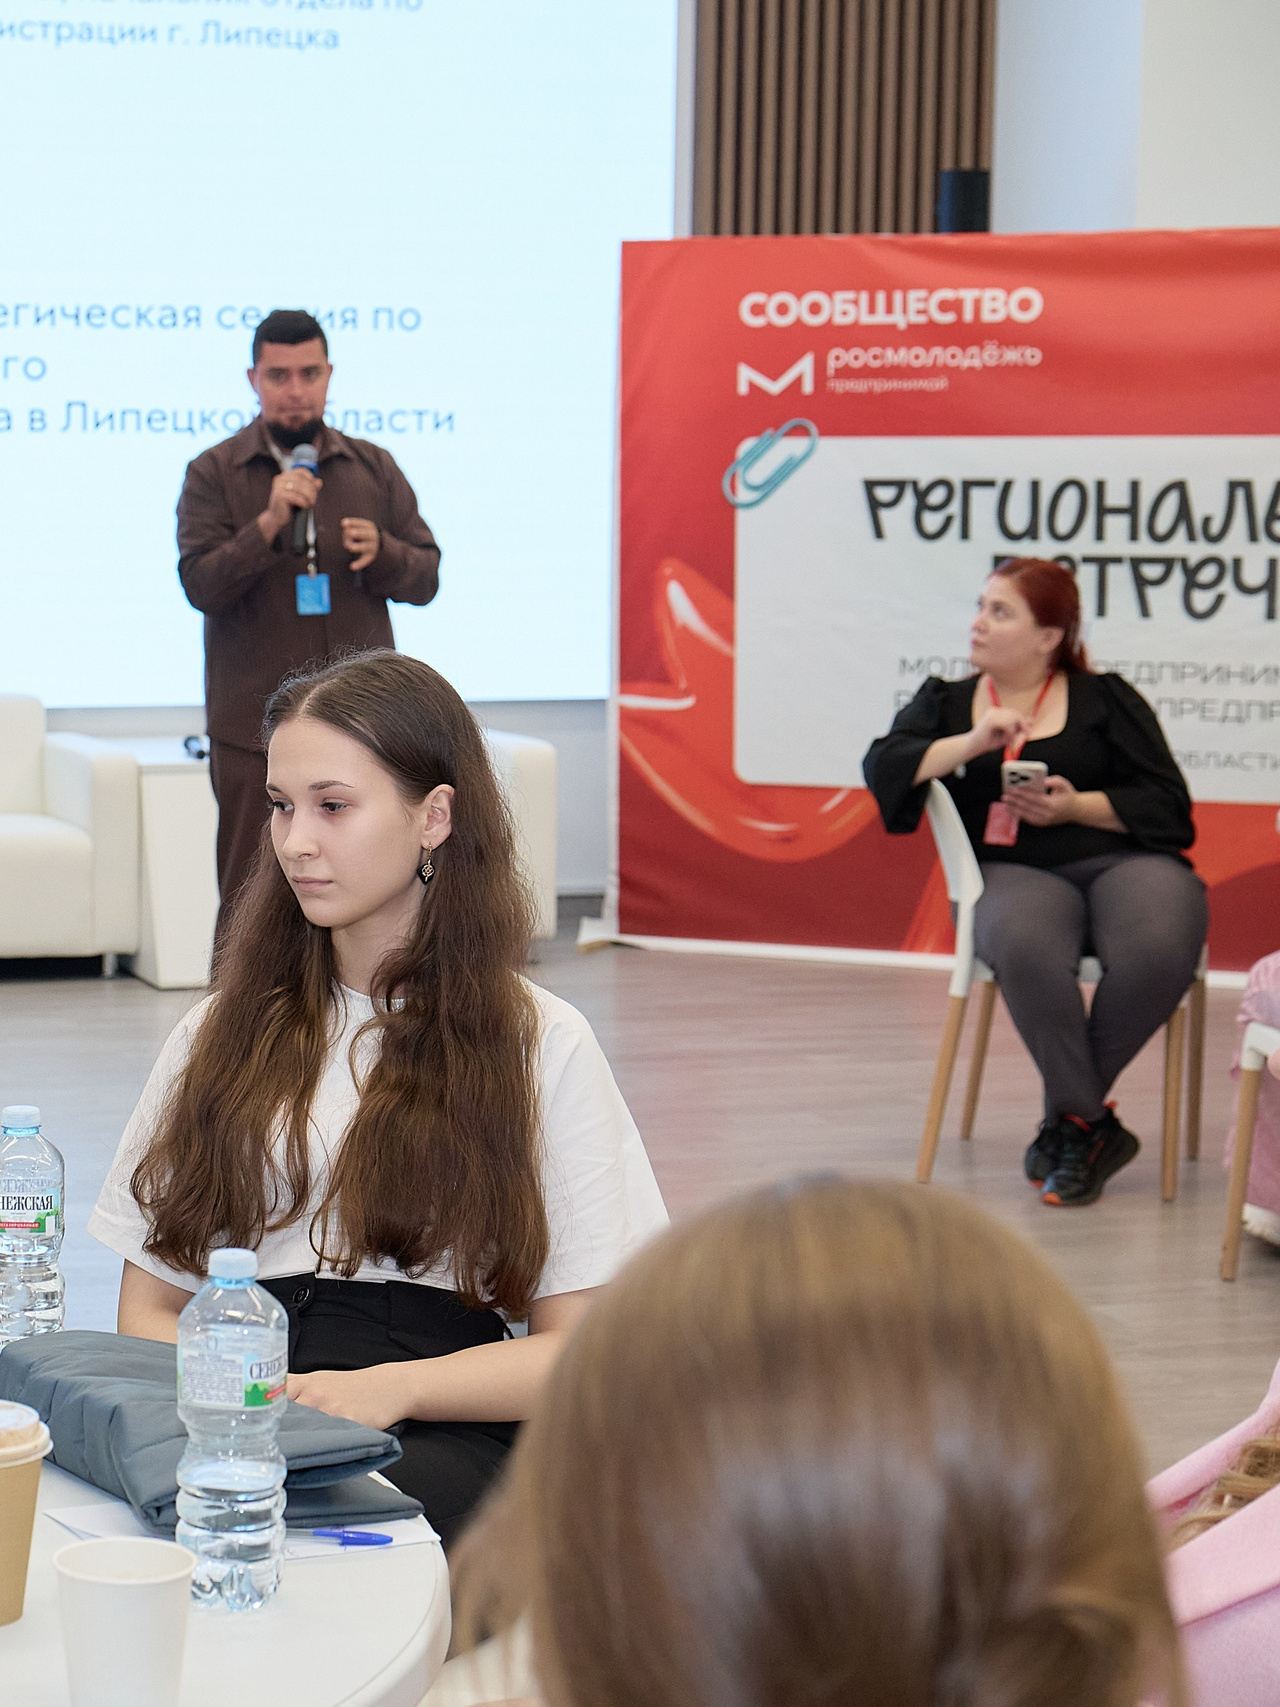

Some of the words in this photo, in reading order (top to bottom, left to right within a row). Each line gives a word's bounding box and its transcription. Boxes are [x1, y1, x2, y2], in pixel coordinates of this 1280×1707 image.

[167, 23, 191, 46] г.
[200, 19, 341, 51] Липецка
[215, 305, 359, 331] сеия
[372, 307, 423, 332] по
[738, 286, 1044, 330] СООБЩЕСТВО
[826, 340, 1044, 377] росмолодёжь
[28, 408, 48, 434] в
[60, 400, 257, 438] Липецко
[323, 400, 456, 434] ласти
